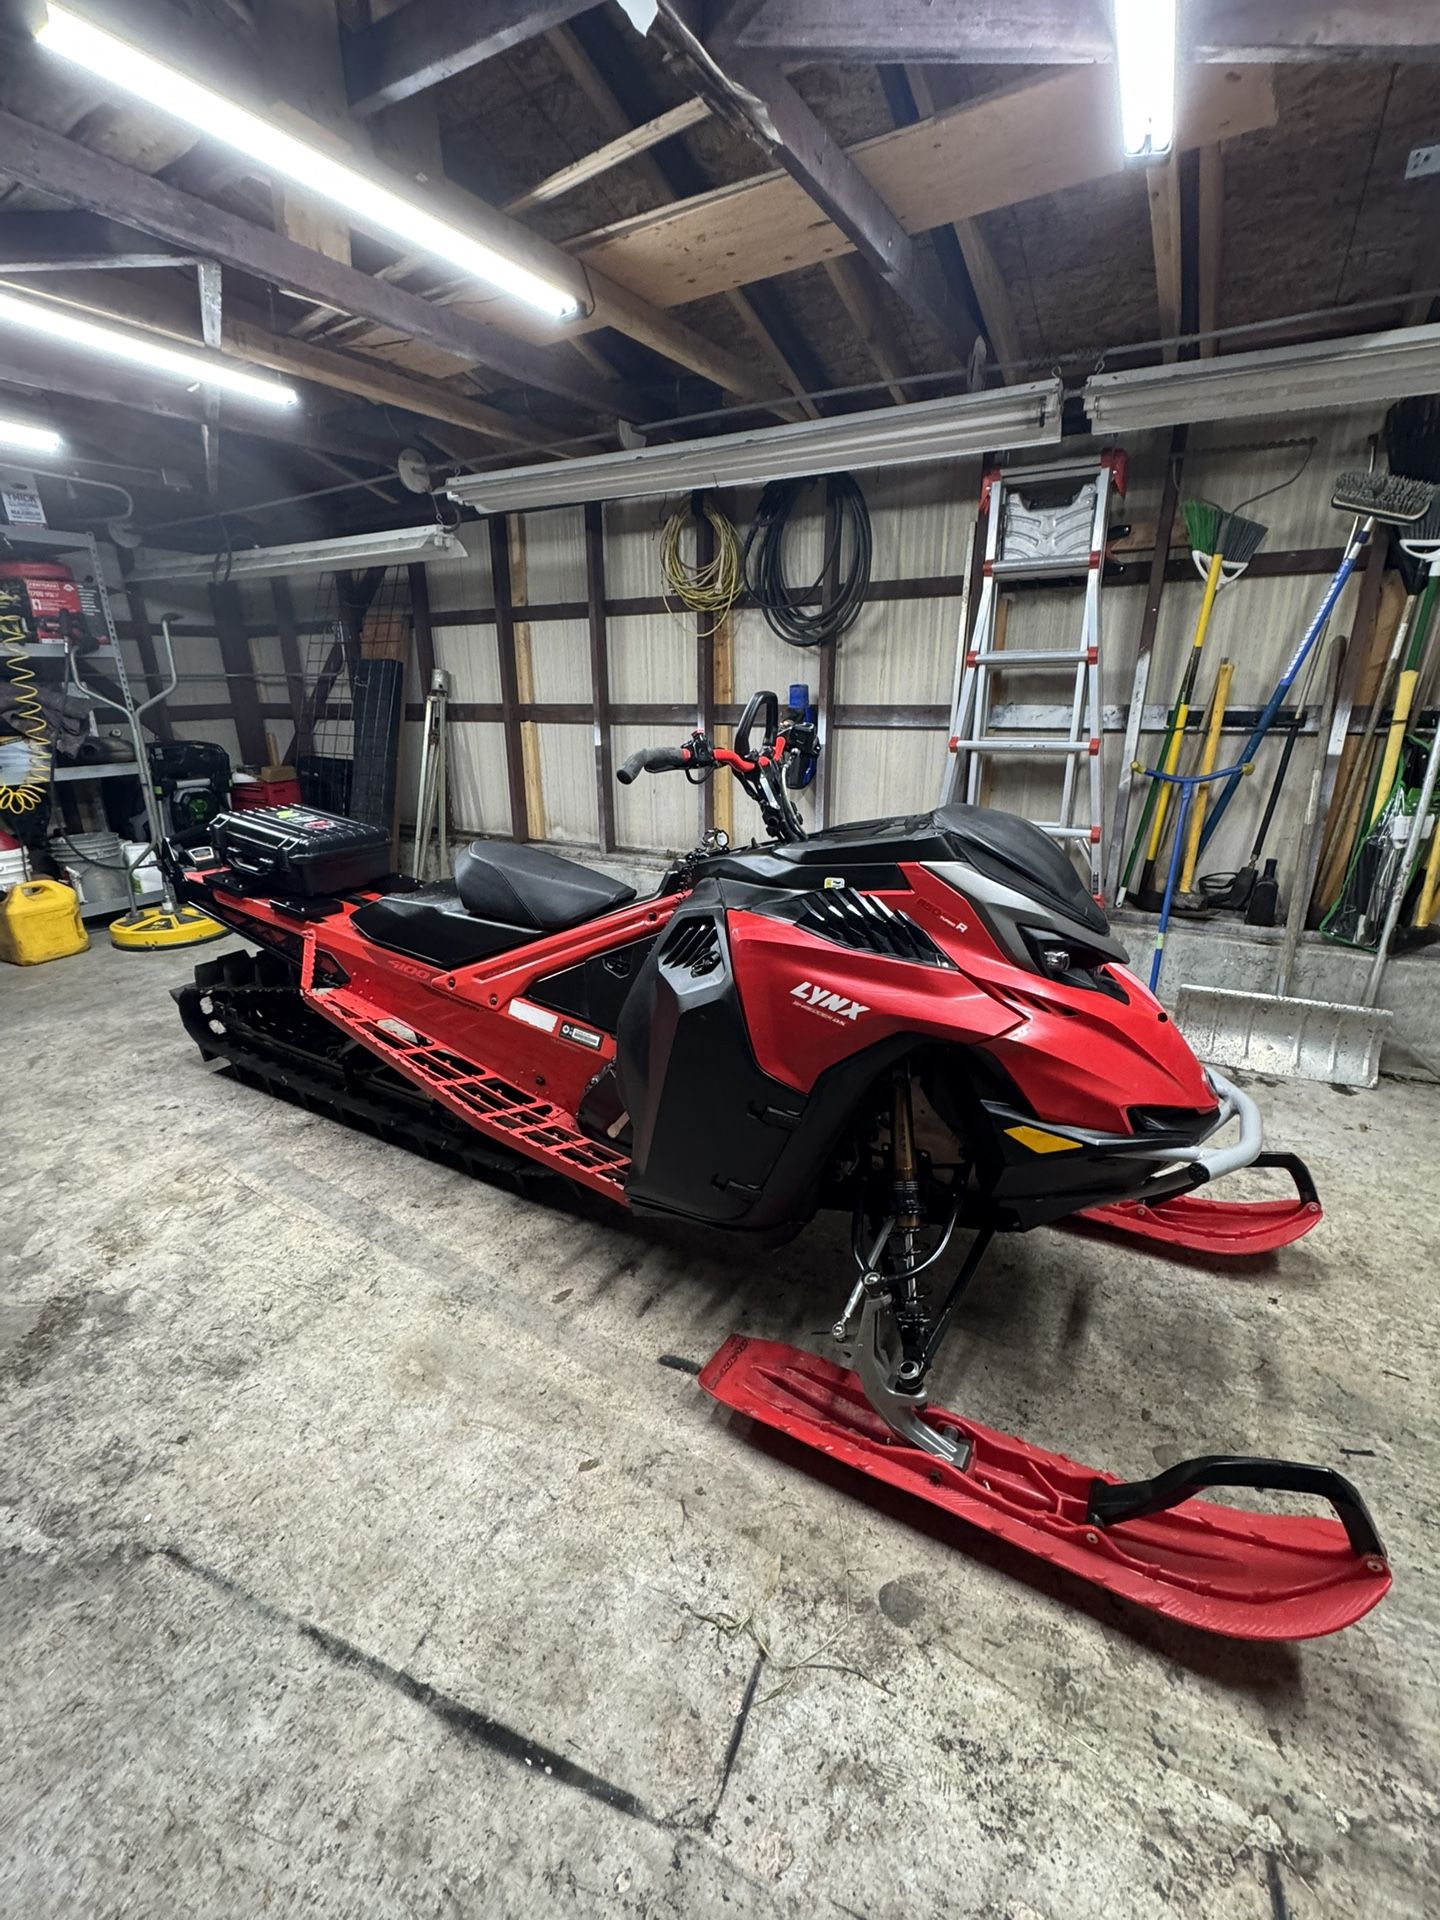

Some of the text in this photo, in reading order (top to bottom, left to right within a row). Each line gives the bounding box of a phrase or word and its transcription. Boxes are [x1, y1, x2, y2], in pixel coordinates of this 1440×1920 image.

[955, 922, 969, 933] R
[387, 959, 430, 979] 4100
[789, 981, 871, 1021] LYNX
